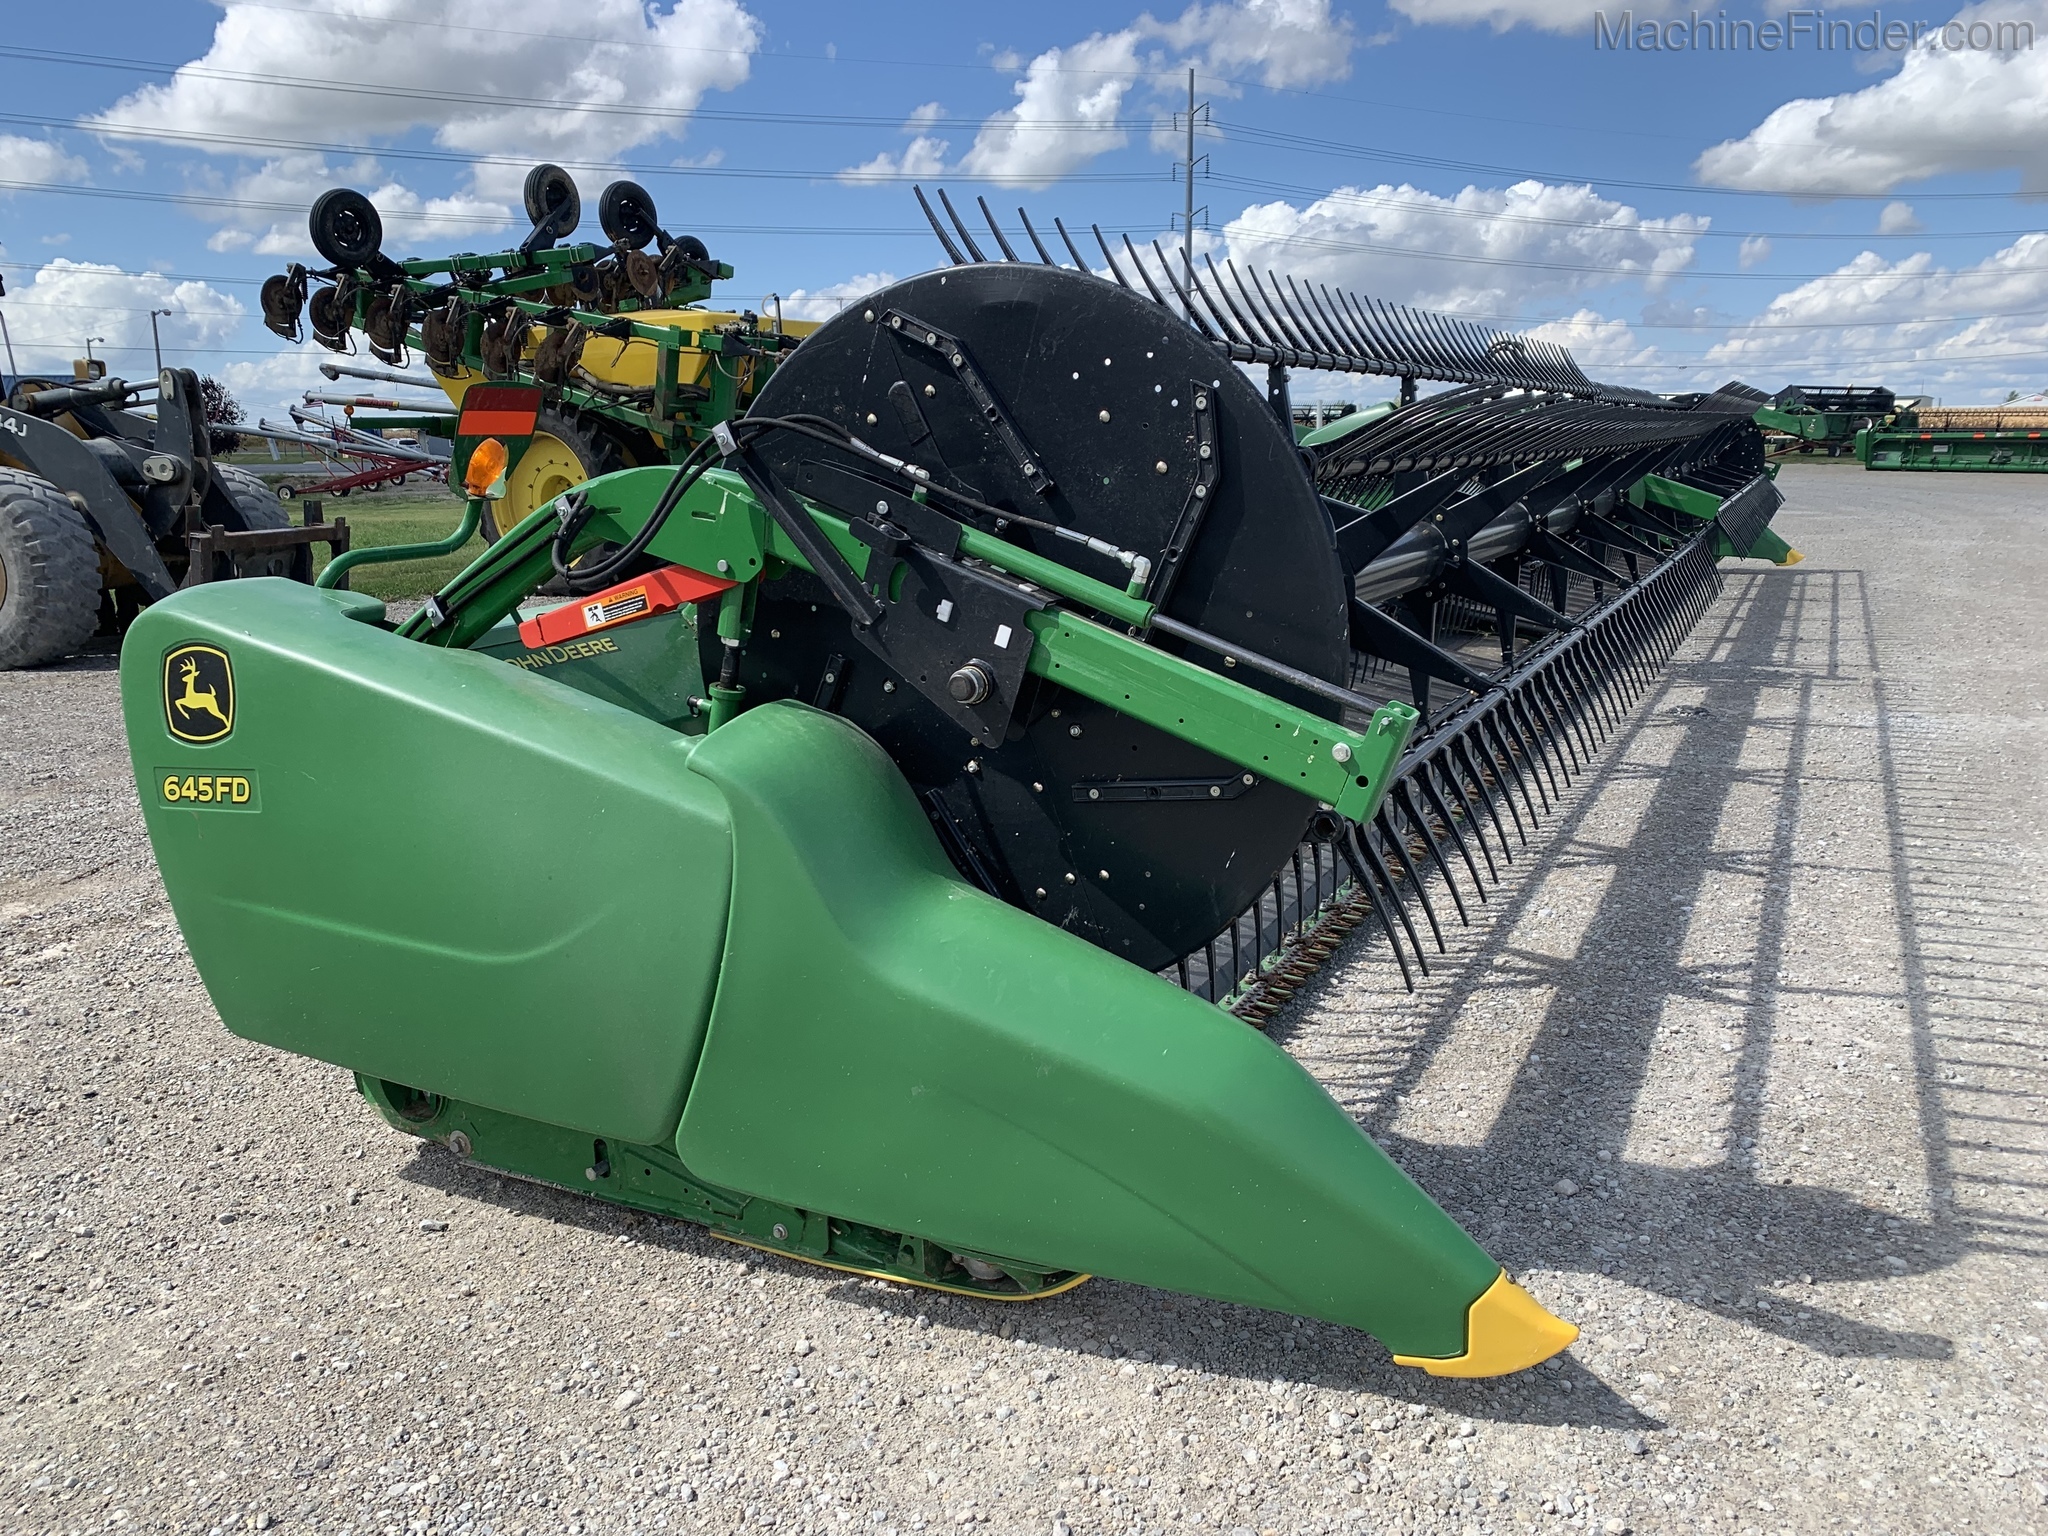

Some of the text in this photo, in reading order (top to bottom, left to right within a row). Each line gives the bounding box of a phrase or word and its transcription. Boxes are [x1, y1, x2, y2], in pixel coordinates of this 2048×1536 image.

[0, 413, 27, 437] 4J
[614, 589, 638, 600] WARNING
[546, 638, 619, 663] DEERE
[163, 775, 251, 804] 645FD
